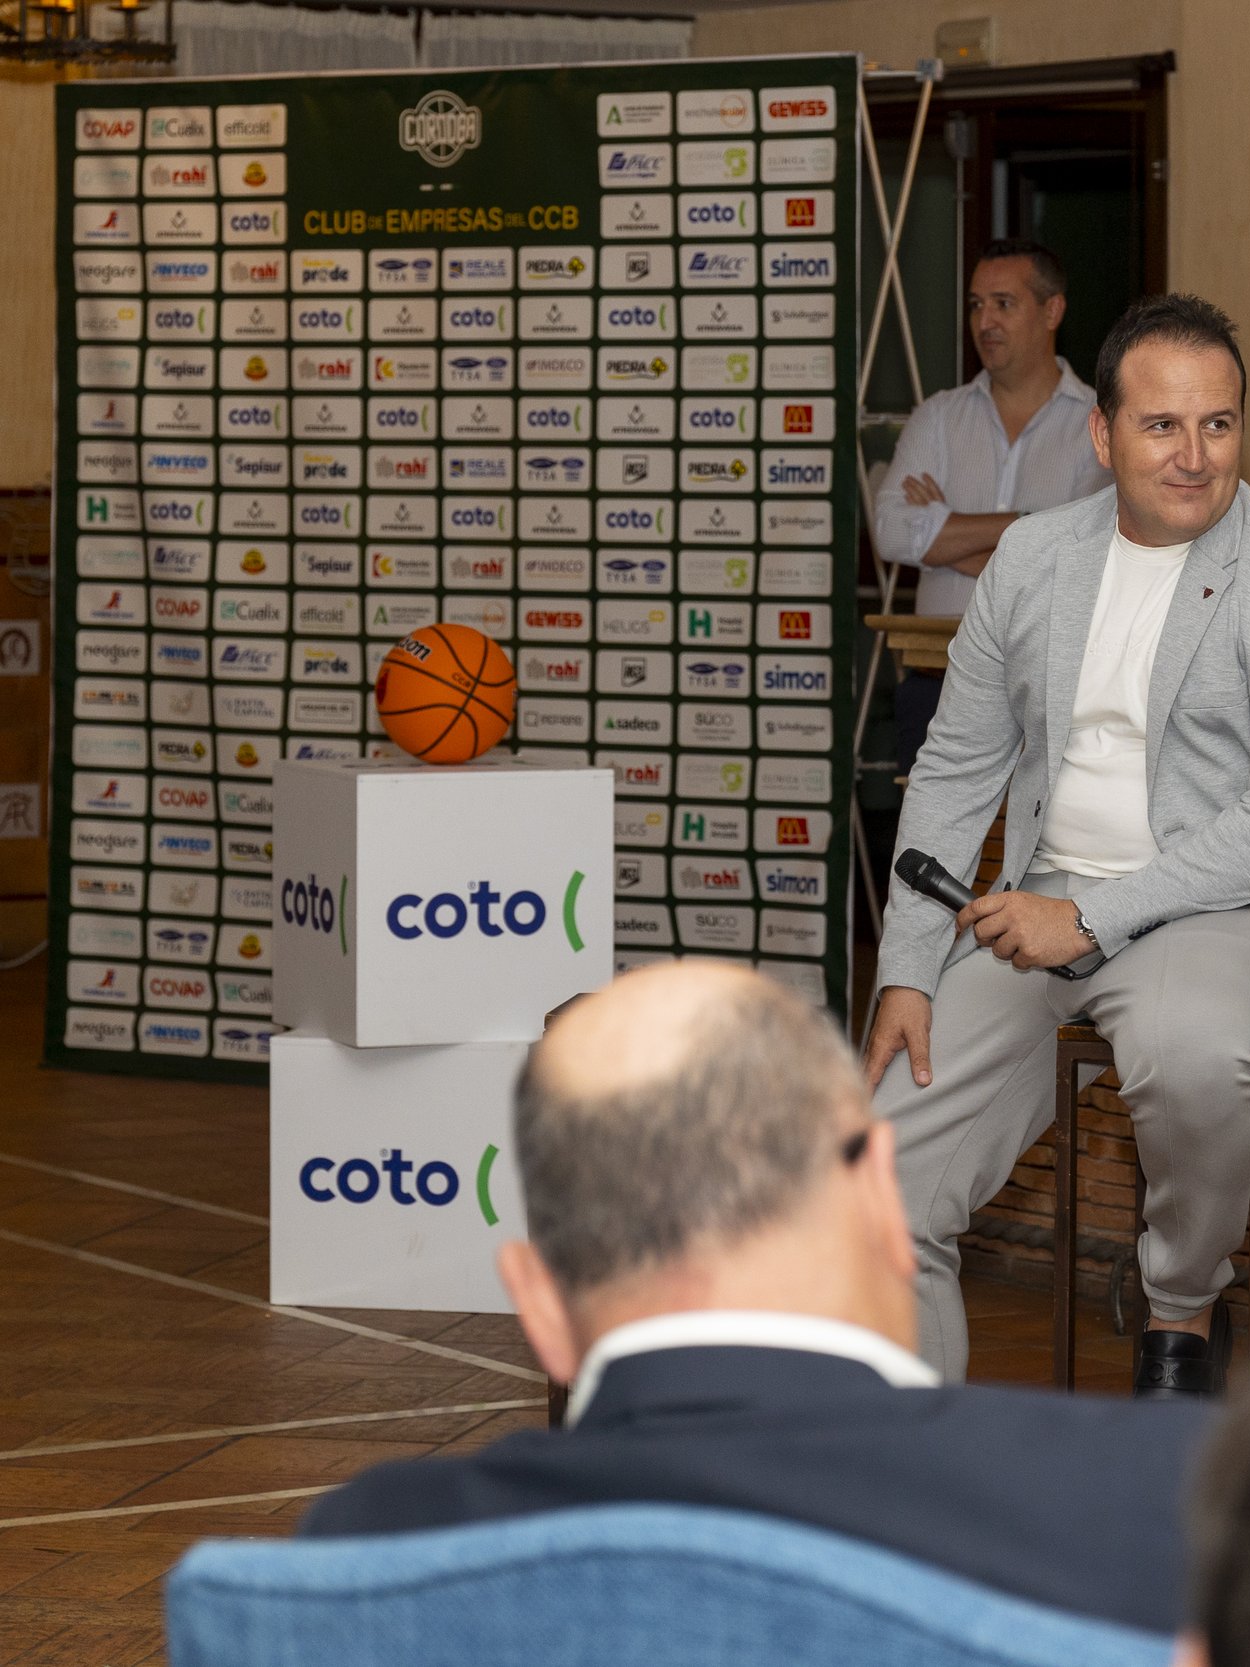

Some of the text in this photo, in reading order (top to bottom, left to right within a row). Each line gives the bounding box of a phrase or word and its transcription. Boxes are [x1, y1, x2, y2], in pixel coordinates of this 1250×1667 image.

[83, 120, 135, 138] COVAP
[231, 213, 270, 231] coto
[303, 210, 366, 235] CLUB
[386, 207, 503, 234] EMPRESAS
[527, 205, 579, 231] CCB
[688, 203, 734, 223] coto
[770, 252, 829, 278] simon
[155, 309, 194, 328] coto
[299, 309, 342, 328] coto
[450, 308, 495, 327] coto
[608, 307, 656, 326] coto
[228, 407, 271, 426] coto
[377, 408, 419, 427] coto
[527, 407, 571, 427] coto
[689, 408, 736, 427] coto
[768, 458, 825, 484] simon
[149, 501, 192, 520] coto
[301, 504, 341, 523] coto
[451, 507, 495, 526] coto
[605, 508, 653, 528] coto
[155, 598, 200, 617] COVAP
[525, 611, 583, 628] GEWISS
[764, 664, 826, 690] simon
[159, 787, 208, 807] COVAP
[766, 868, 818, 895] simon
[282, 874, 335, 933] coto
[386, 880, 547, 940] coto
[151, 978, 205, 998] COVAP
[300, 1149, 459, 1207] coto
